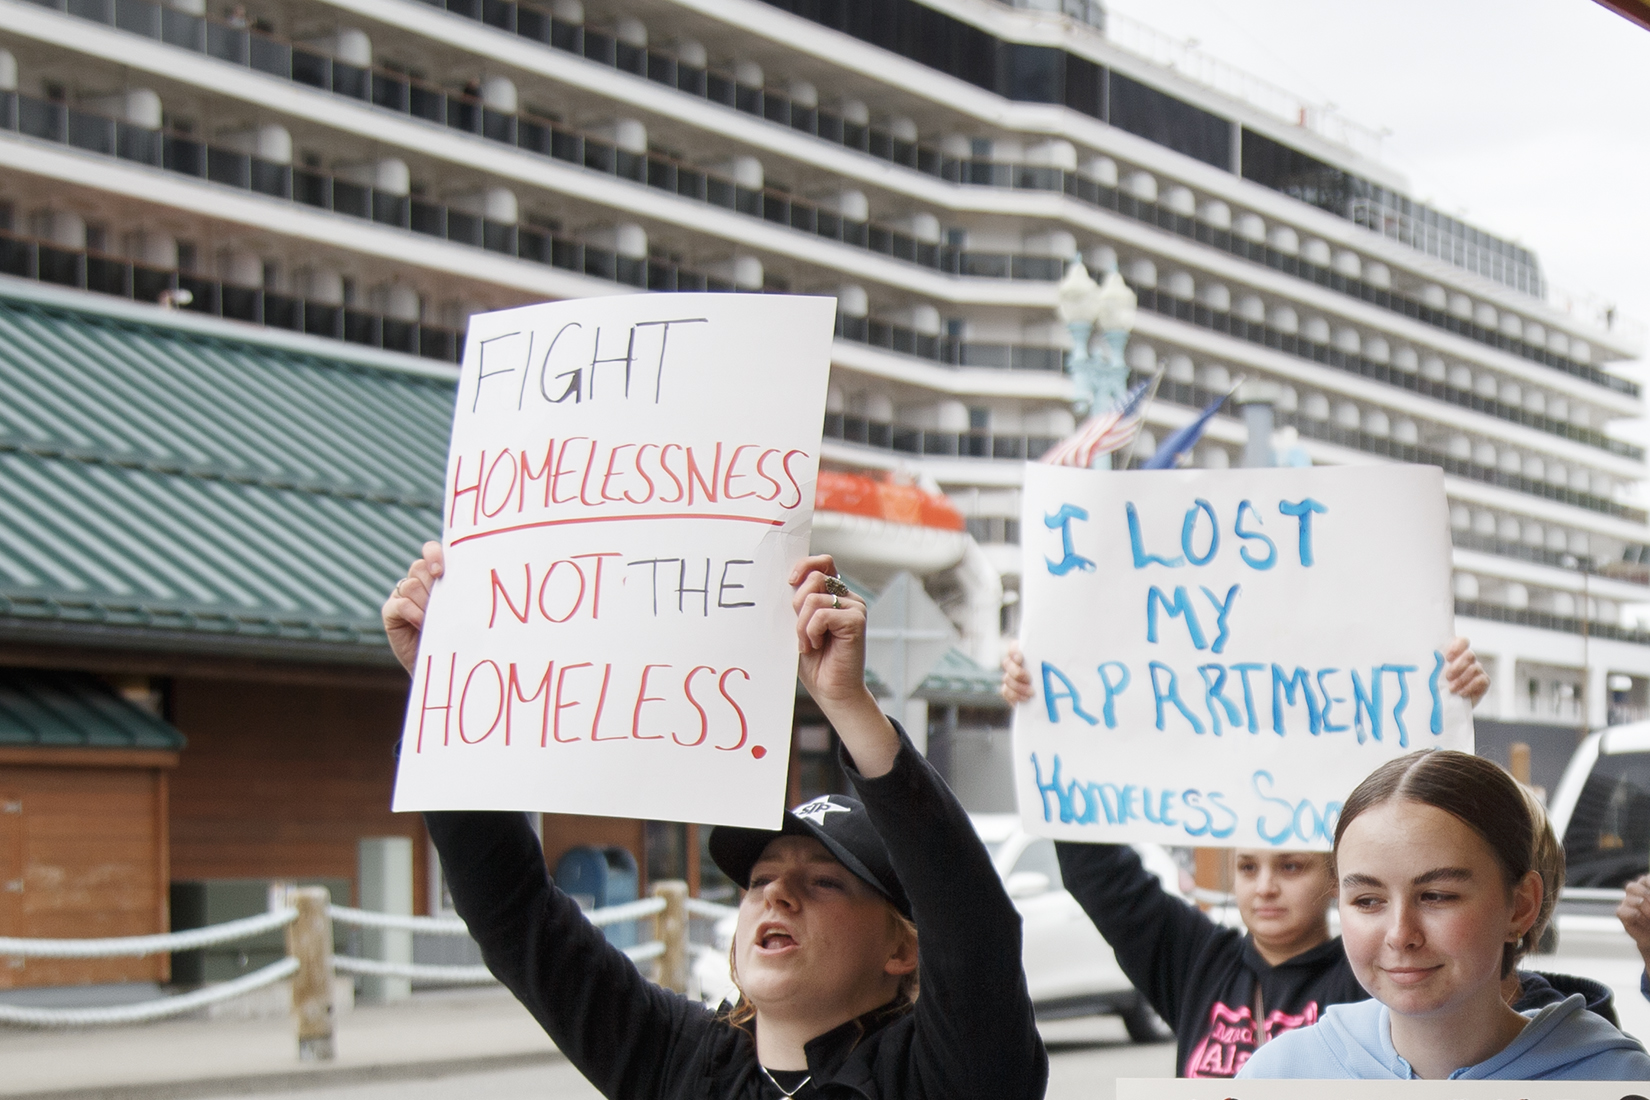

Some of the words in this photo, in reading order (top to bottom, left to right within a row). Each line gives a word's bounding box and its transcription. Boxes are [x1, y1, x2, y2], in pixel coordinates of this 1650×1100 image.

[473, 318, 708, 412] FIGHT
[450, 436, 810, 528] HOMELESSNESS
[1045, 503, 1097, 576] I
[1125, 498, 1329, 571] LOST
[489, 553, 623, 629] NOT
[627, 558, 756, 617] THE
[1147, 583, 1242, 654] MY
[417, 652, 767, 759] HOMELESS.
